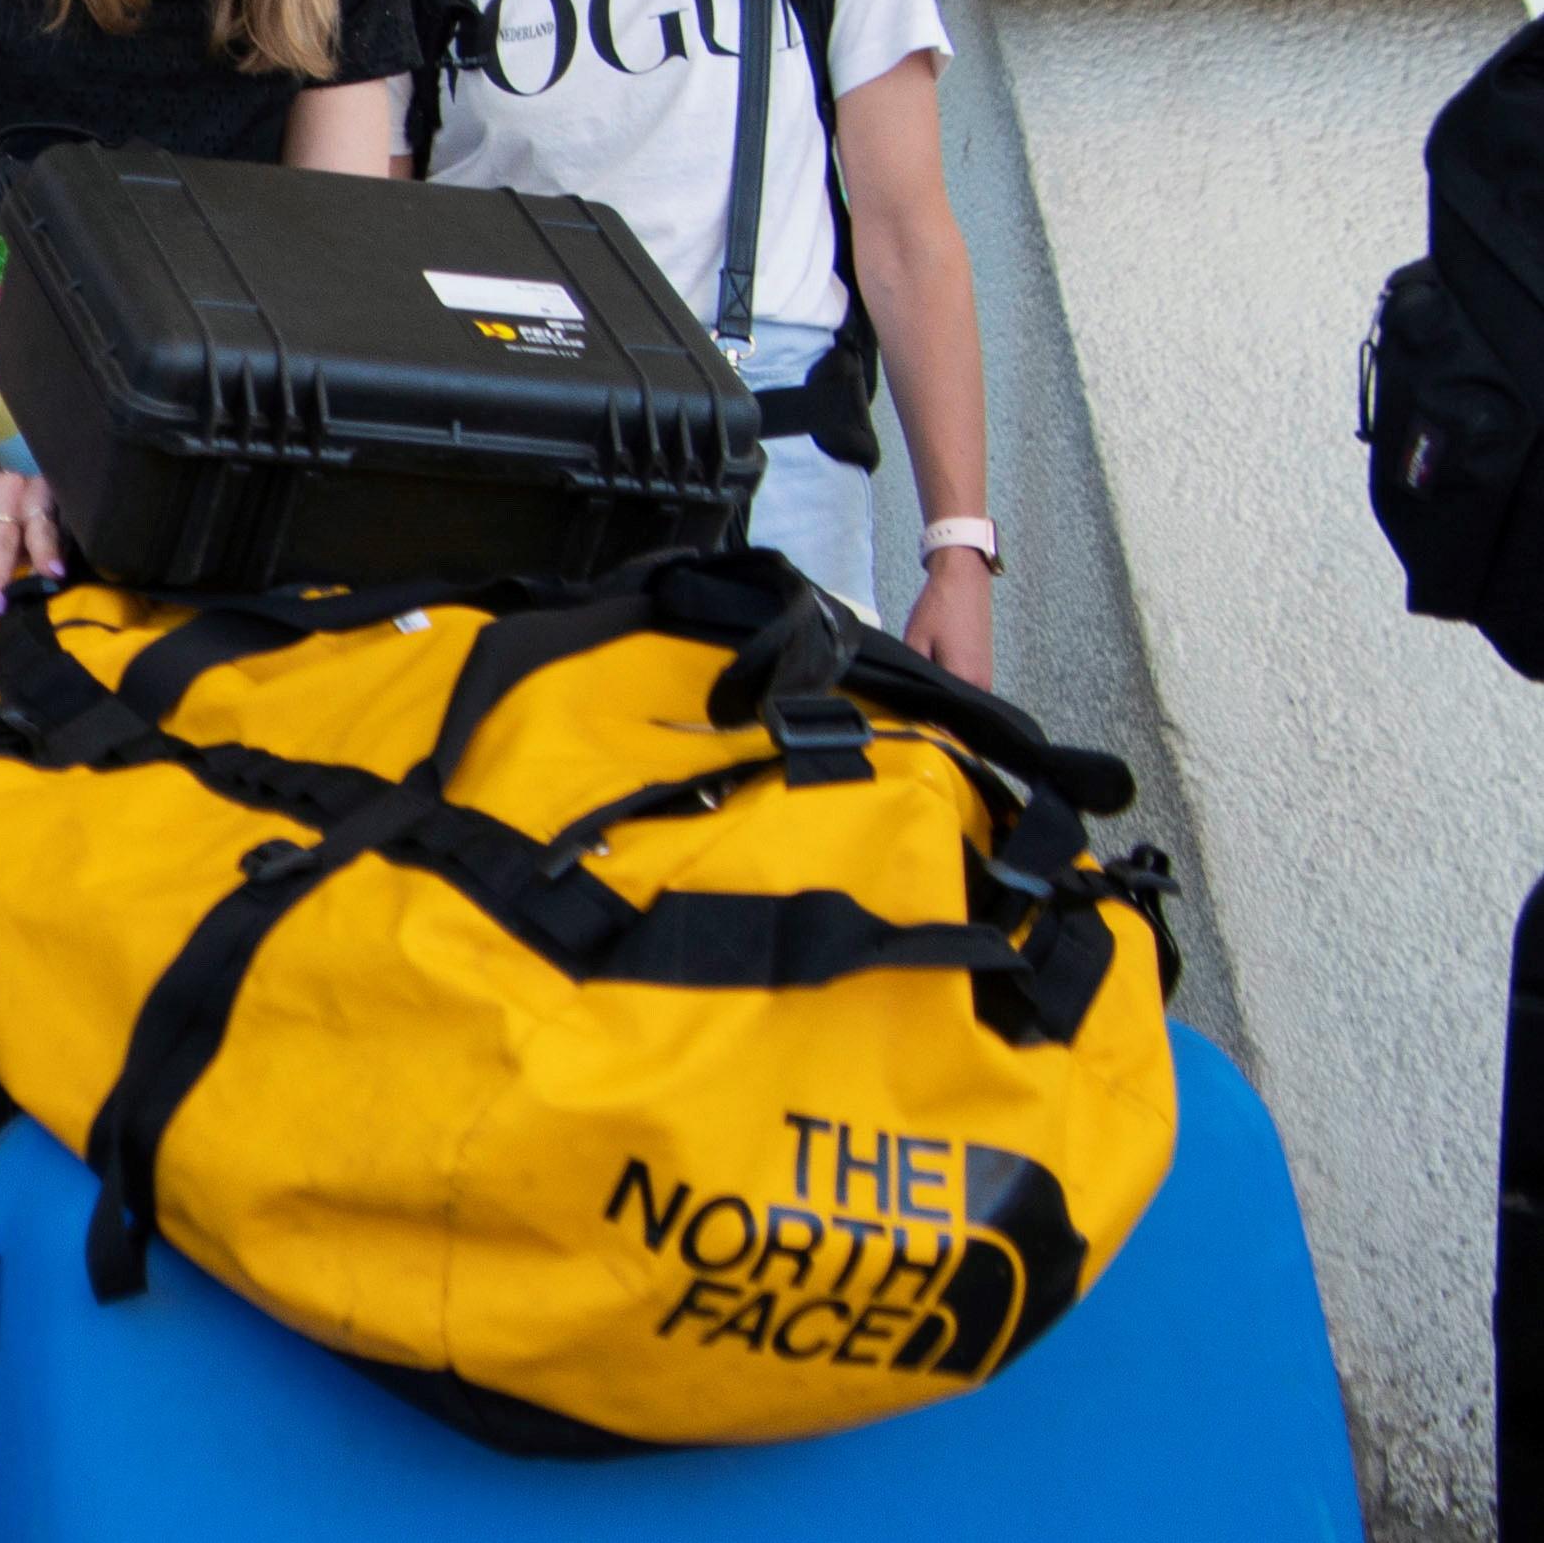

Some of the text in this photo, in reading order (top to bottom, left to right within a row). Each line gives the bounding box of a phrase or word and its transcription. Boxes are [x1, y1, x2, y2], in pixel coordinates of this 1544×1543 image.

[498, 21, 556, 43] NEDERLAND
[785, 1109, 952, 1225] THE
[603, 1158, 952, 1306] NORTH
[656, 1273, 911, 1371] FACE
